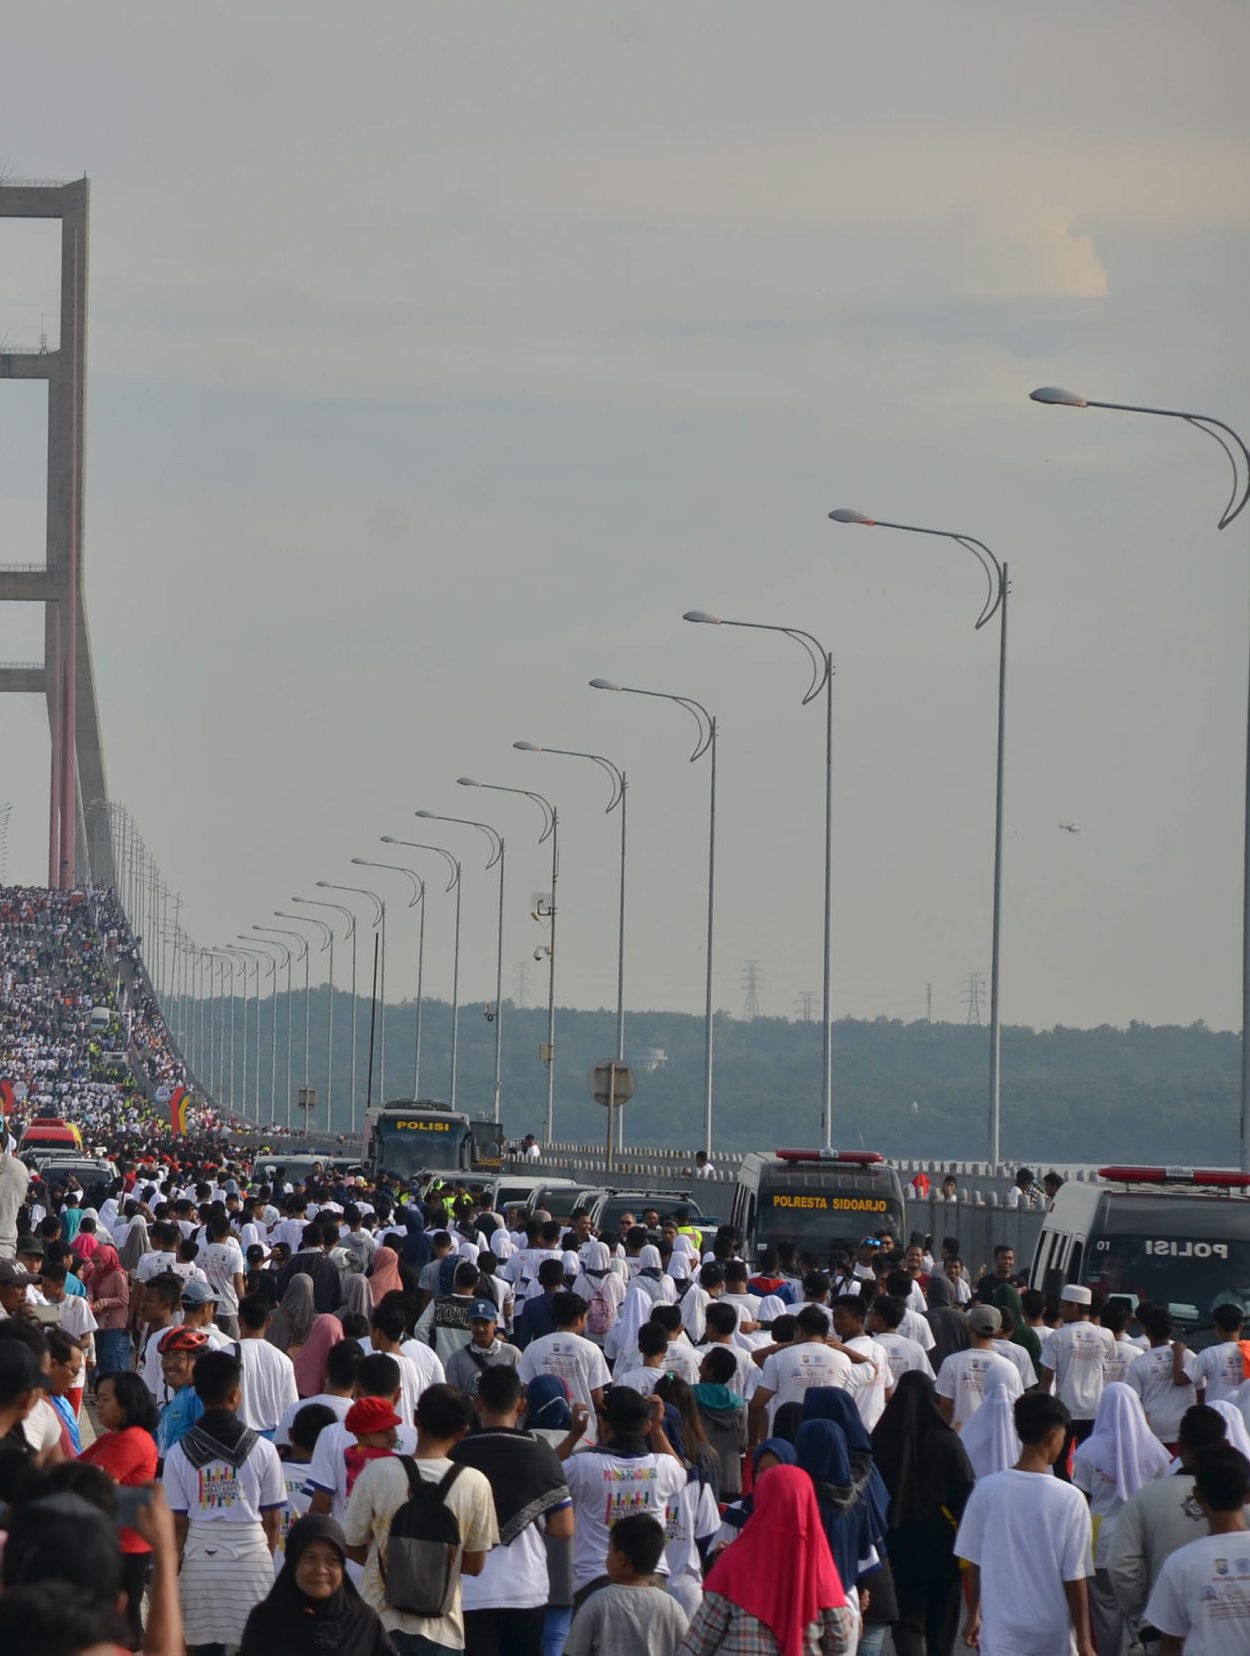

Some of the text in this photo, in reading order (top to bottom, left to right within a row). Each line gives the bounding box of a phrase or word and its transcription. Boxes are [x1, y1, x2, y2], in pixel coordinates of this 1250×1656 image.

[396, 1120, 450, 1132] POLISI
[772, 1194, 888, 1213] POLRESTA SIDOARJO
